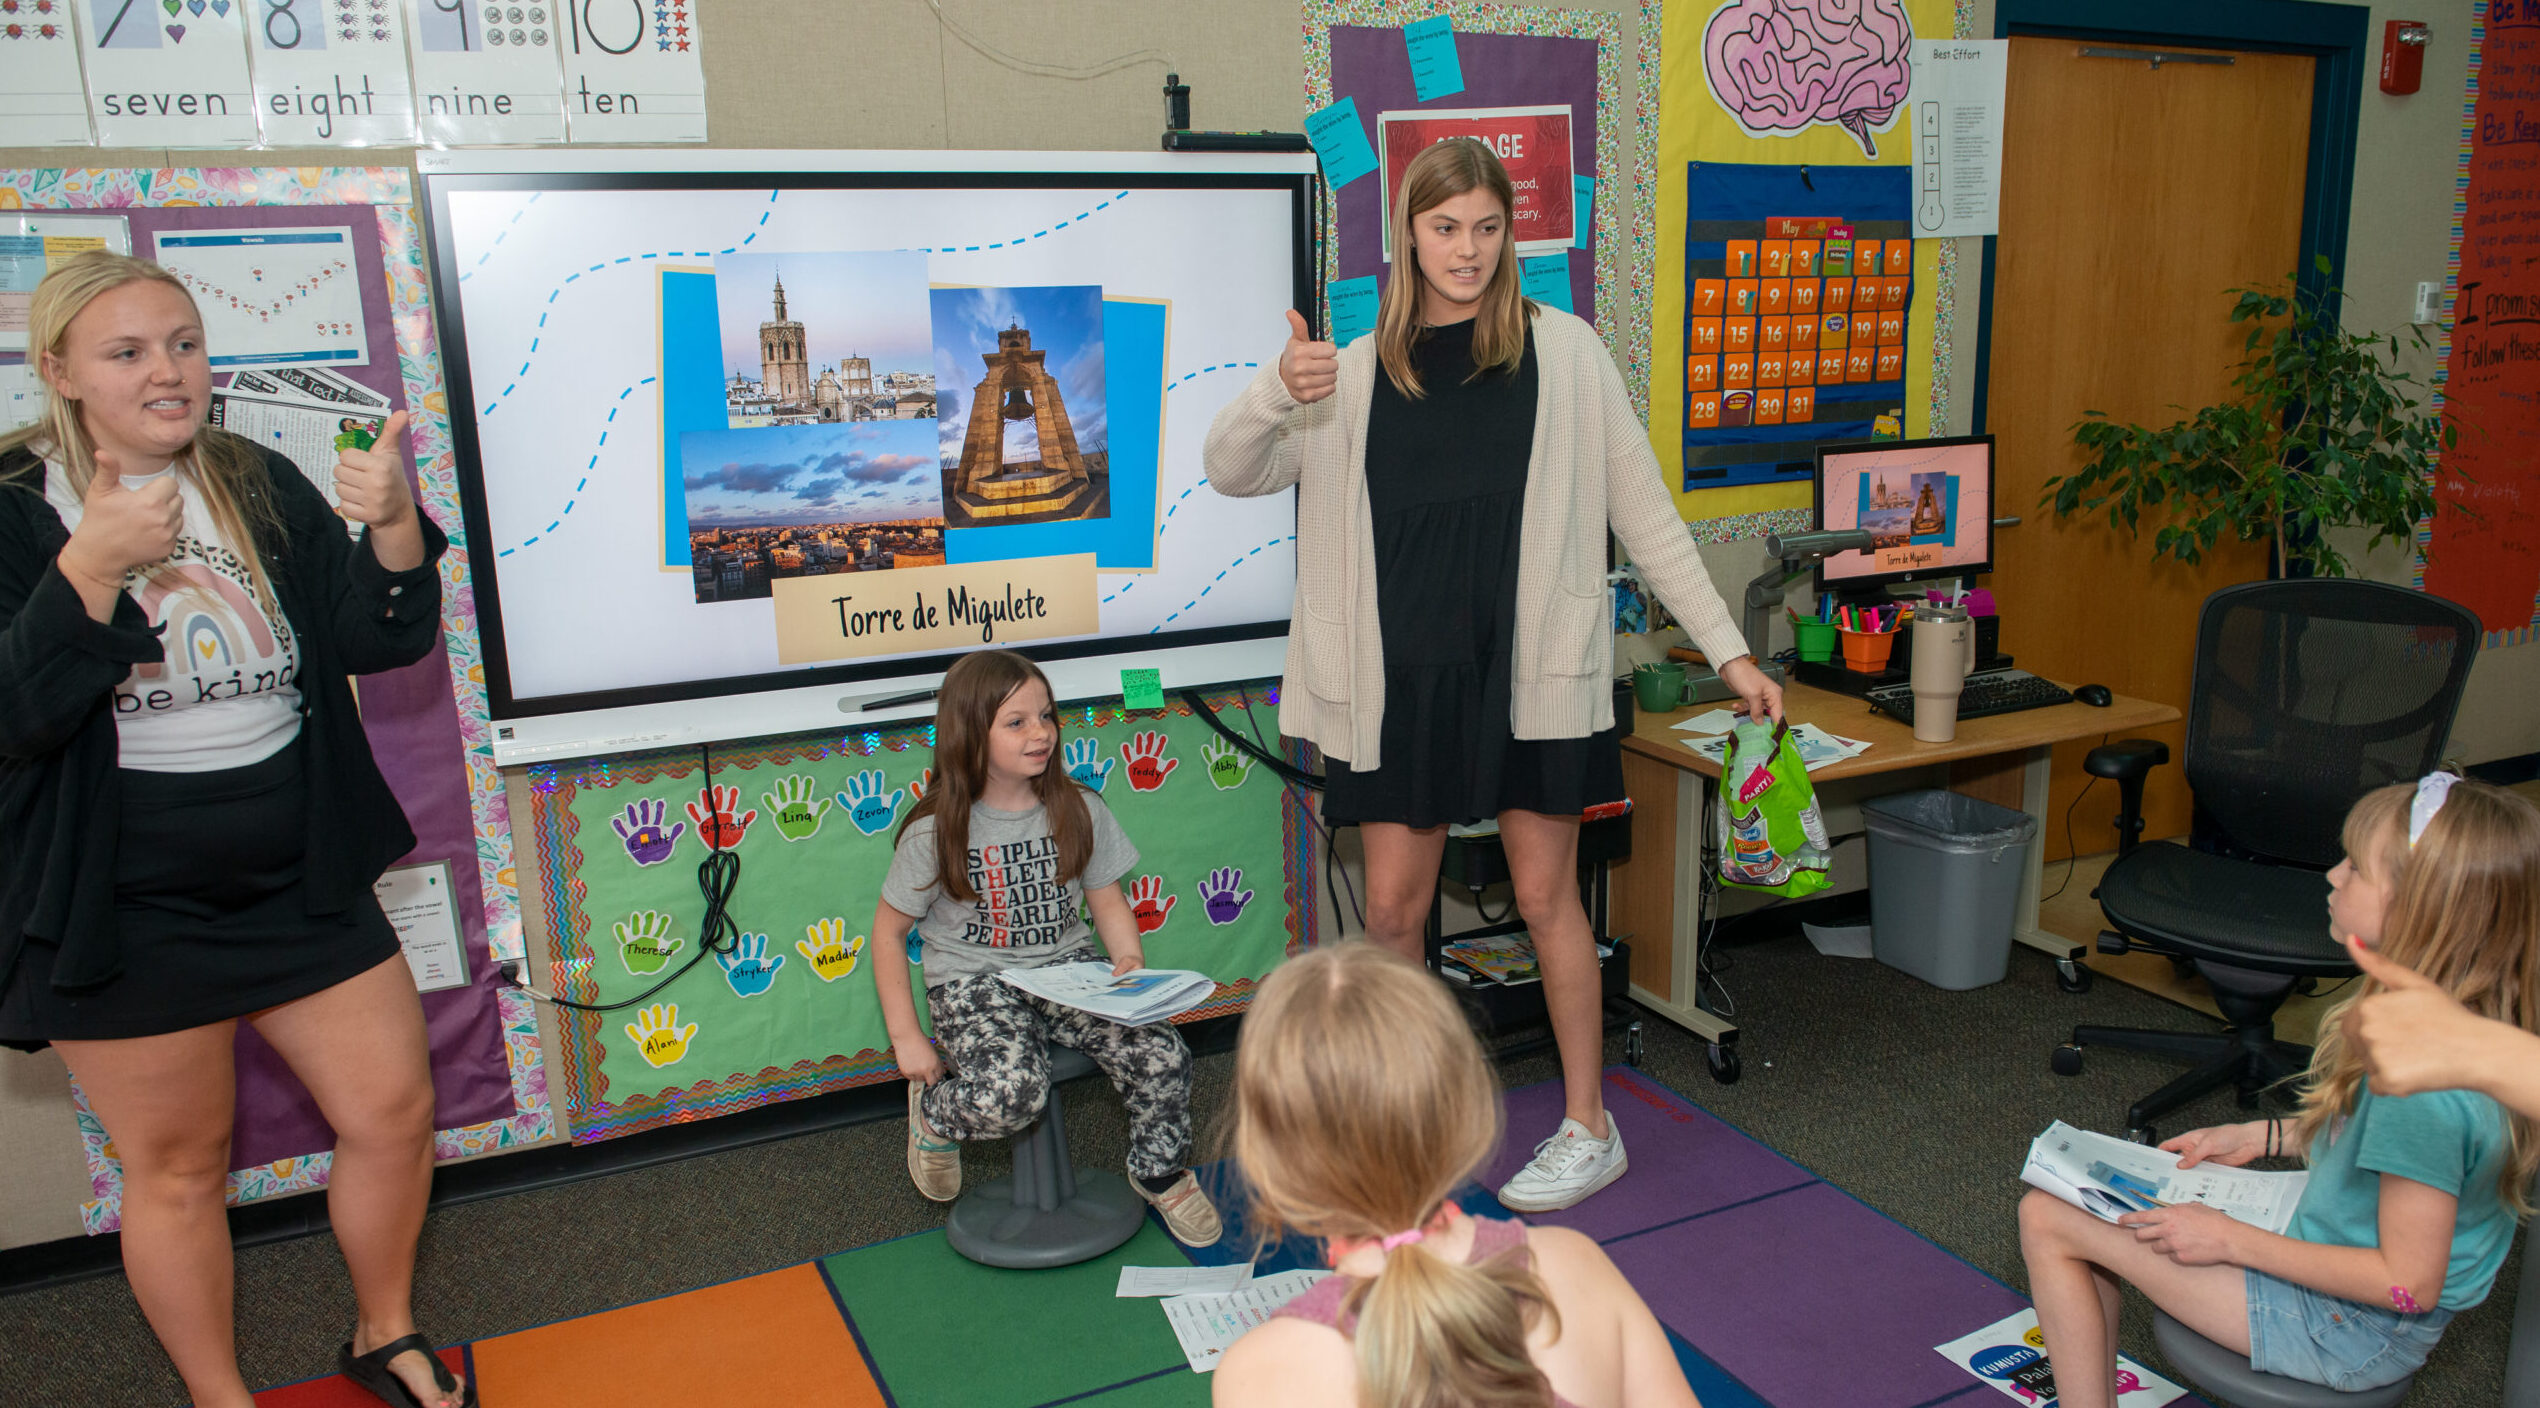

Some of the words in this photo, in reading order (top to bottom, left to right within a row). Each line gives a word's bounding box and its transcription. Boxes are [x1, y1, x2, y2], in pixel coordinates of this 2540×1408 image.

[1933, 49, 1951, 60] Best
[1952, 49, 1981, 60] Effort
[428, 86, 513, 115] nine
[578, 75, 639, 114] ten
[104, 93, 228, 116] seven
[270, 75, 375, 138] eight
[1928, 116, 1933, 125] 4
[2483, 112, 2506, 142] Be
[1929, 146, 1934, 156] 3
[1511, 178, 1539, 192] good,
[1929, 173, 1934, 182] 2
[1512, 210, 1541, 222] scary.
[1782, 220, 1800, 237] May
[1770, 251, 1779, 268] 2
[1800, 251, 1809, 268] 3
[1863, 251, 1872, 267] 5
[1893, 250, 1901, 266] 6
[1704, 289, 1715, 306] 7
[1738, 289, 1747, 306] 8
[1769, 288, 1780, 305] 9
[1796, 288, 1813, 305] 10
[1832, 287, 1844, 304] 11
[1860, 286, 1875, 303] 12
[1886, 286, 1901, 303] 13
[2460, 282, 2482, 325] I
[1698, 326, 1715, 344] 14
[1731, 326, 1748, 343] 15
[1766, 326, 1782, 342] 16
[1796, 325, 1812, 341] 17
[1857, 322, 1871, 339] 19
[1881, 320, 1899, 337] 20
[2461, 334, 2507, 370] follow
[1728, 363, 1749, 380] 22
[1761, 362, 1782, 378] 23
[1791, 360, 1810, 377] 24
[1822, 359, 1841, 376] 25
[1851, 357, 1868, 373] 26
[1880, 355, 1899, 372] 27
[1694, 364, 1711, 382] 21
[280, 368, 306, 389] that
[307, 377, 334, 401] Text
[14, 391, 24, 400] ar
[1695, 402, 1715, 419] 28
[1760, 398, 1780, 415] 30
[1792, 397, 1809, 414] 31
[1886, 553, 1901, 566] Torre
[1903, 552, 1908, 564] de
[1910, 551, 1931, 568] Migulete
[831, 596, 904, 637] Torre
[913, 592, 939, 630] de
[947, 582, 1047, 643] Migulete
[113, 686, 174, 713] be
[191, 653, 294, 704] kind
[1132, 766, 1162, 784] Teddy
[1213, 761, 1239, 775] Abby
[857, 805, 890, 821] Zevon
[626, 942, 674, 957] Theresa
[816, 948, 858, 968] Maddie
[733, 963, 774, 980] Stryker
[1978, 1348, 2036, 1376] KUMUSTA
